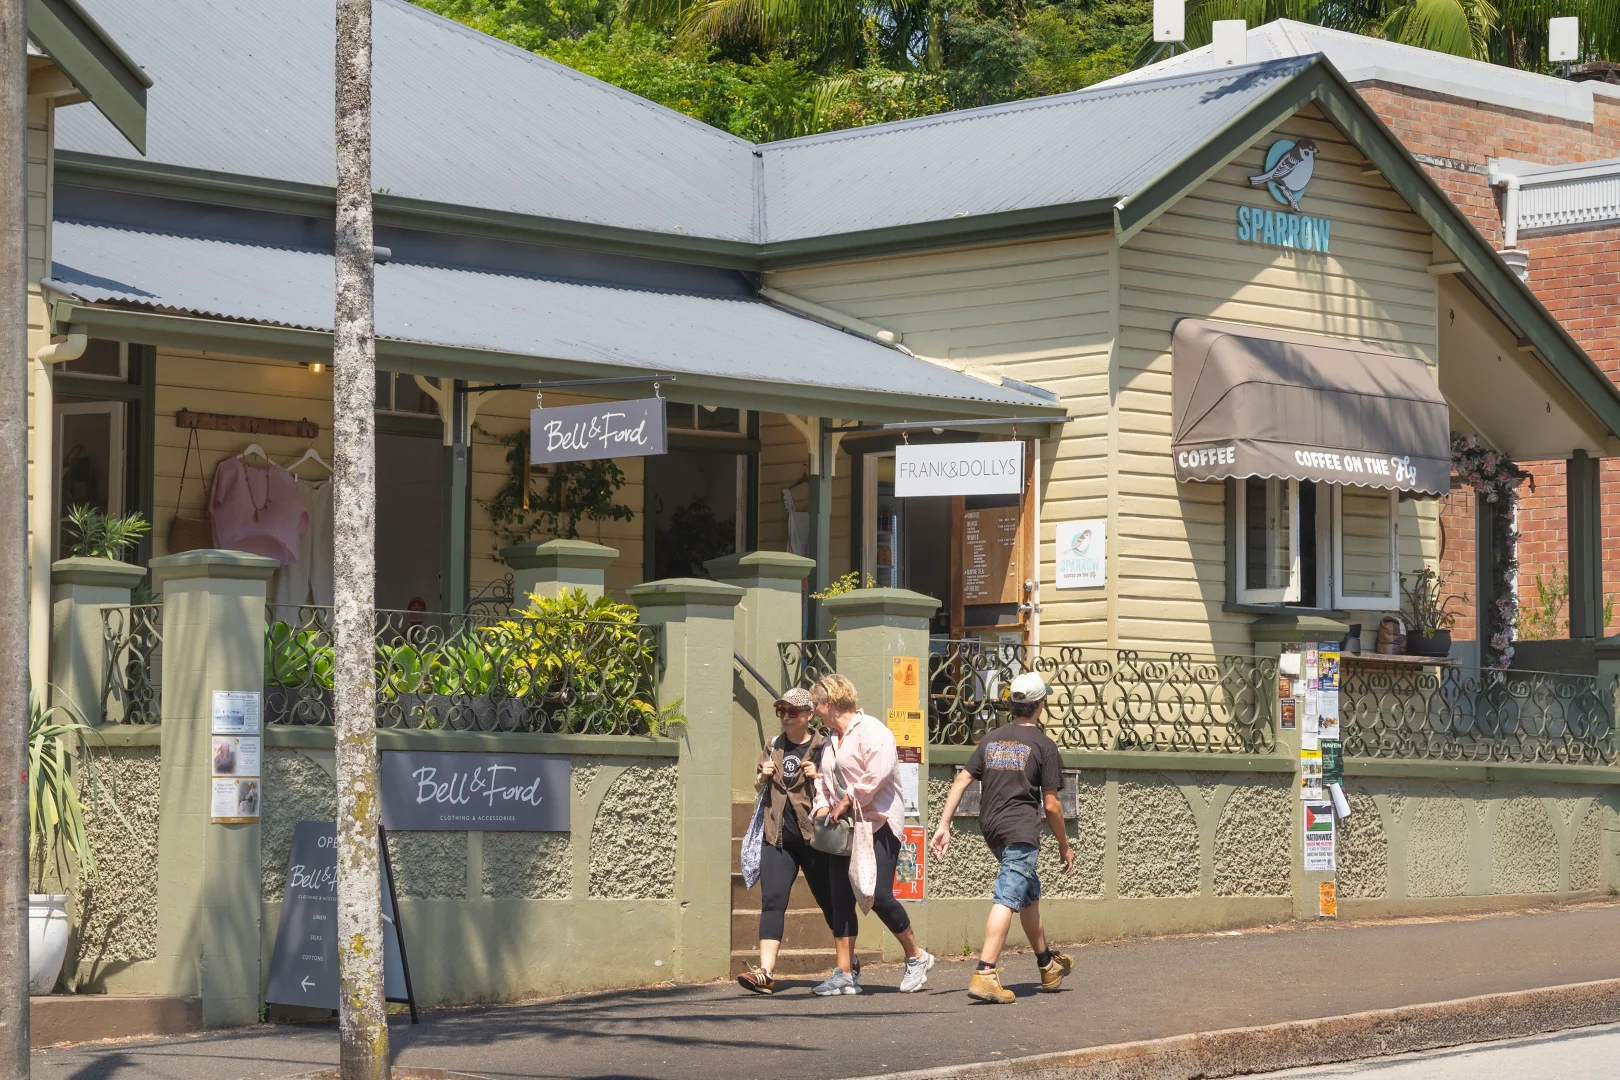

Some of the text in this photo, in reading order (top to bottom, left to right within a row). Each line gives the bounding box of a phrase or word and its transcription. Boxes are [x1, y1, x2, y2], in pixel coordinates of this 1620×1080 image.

[1237, 206, 1330, 252] SPARROW
[1178, 447, 1235, 468] COFFEE
[1294, 450, 1417, 486] COFFEE ON THE Fly
[1060, 558, 1100, 572] SPARROW
[318, 836, 338, 848] OPE
[1306, 833, 1332, 841] NATIONWIDE
